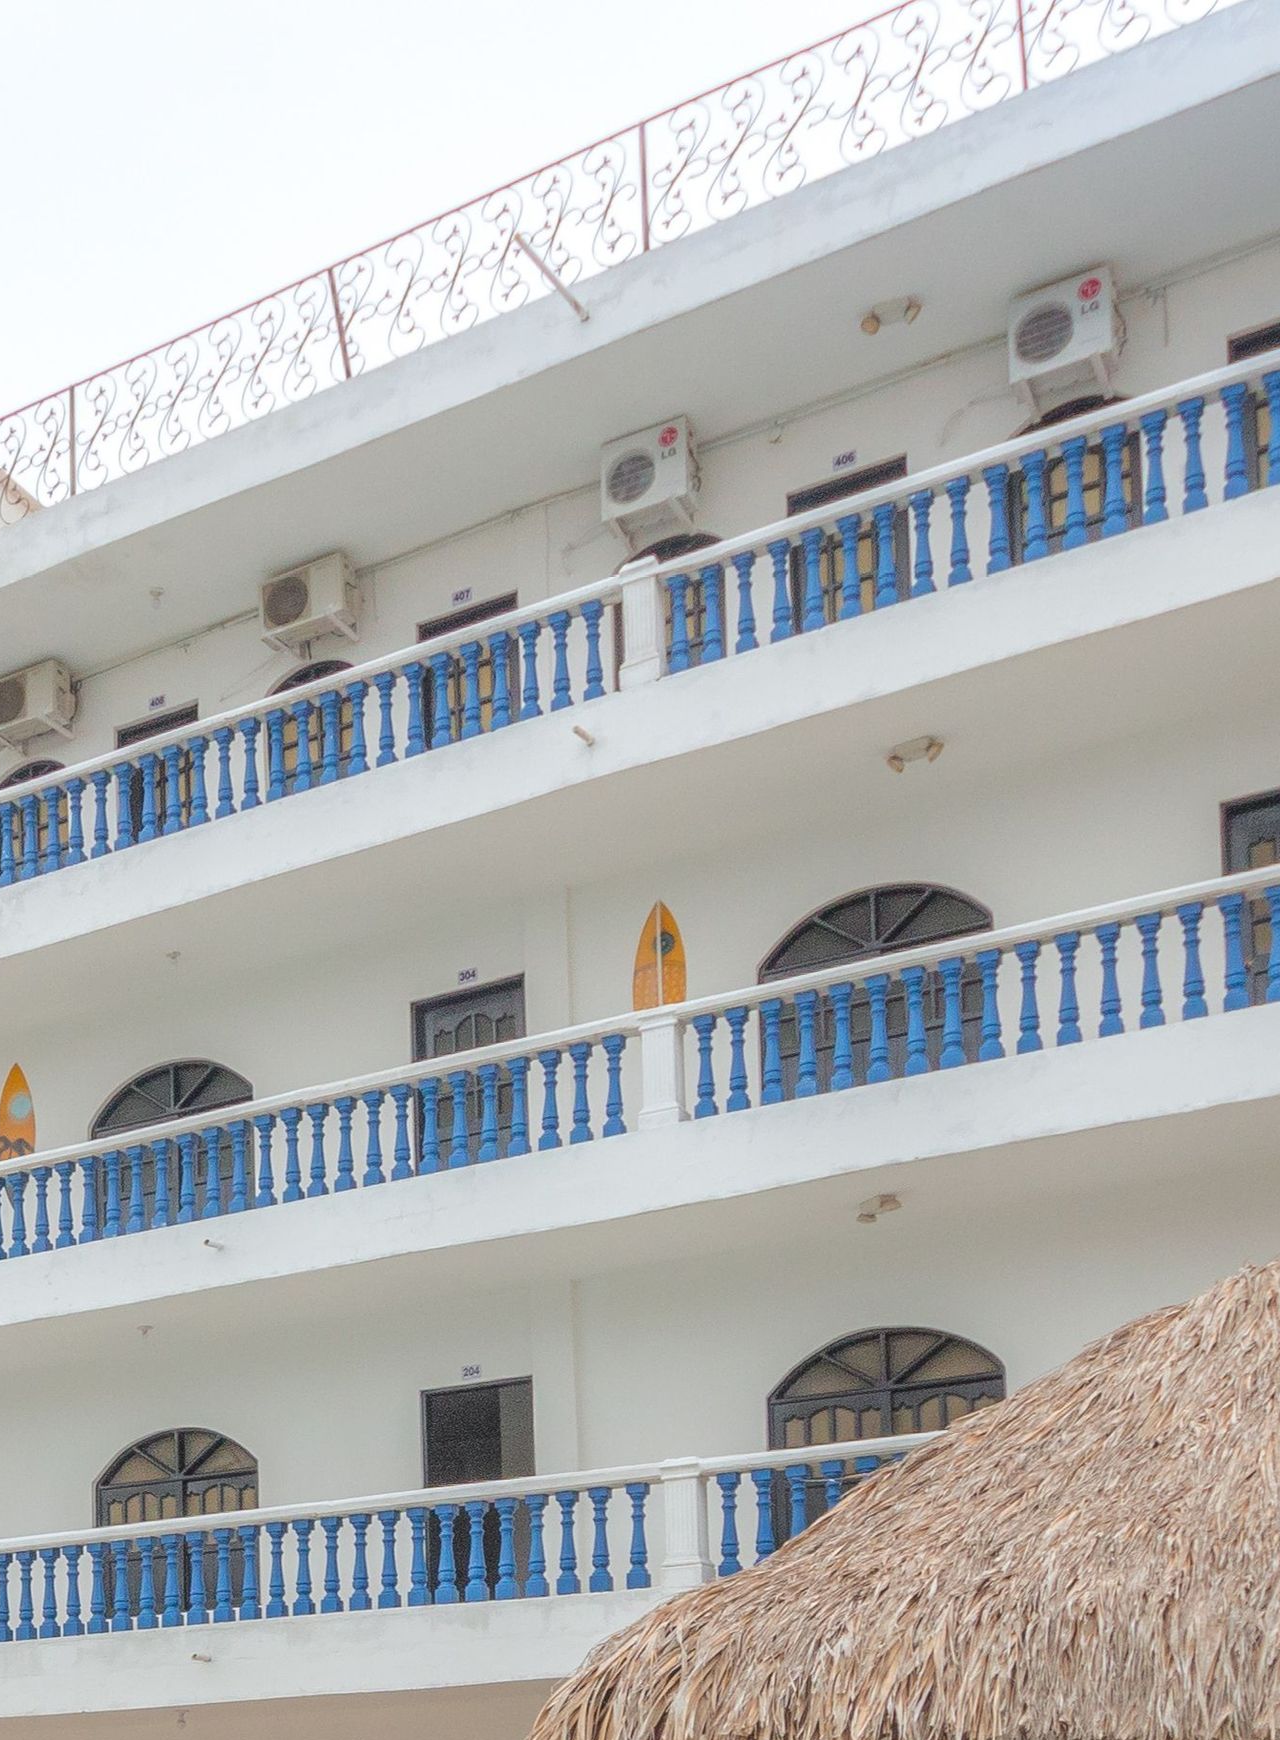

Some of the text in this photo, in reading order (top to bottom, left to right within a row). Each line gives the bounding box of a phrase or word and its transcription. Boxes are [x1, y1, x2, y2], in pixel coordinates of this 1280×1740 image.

[1081, 299, 1099, 315] LG
[661, 446, 677, 460] LG
[835, 450, 856, 467] 406
[453, 589, 472, 602] 407
[459, 969, 476, 982] 304
[463, 1367, 480, 1377] 204
